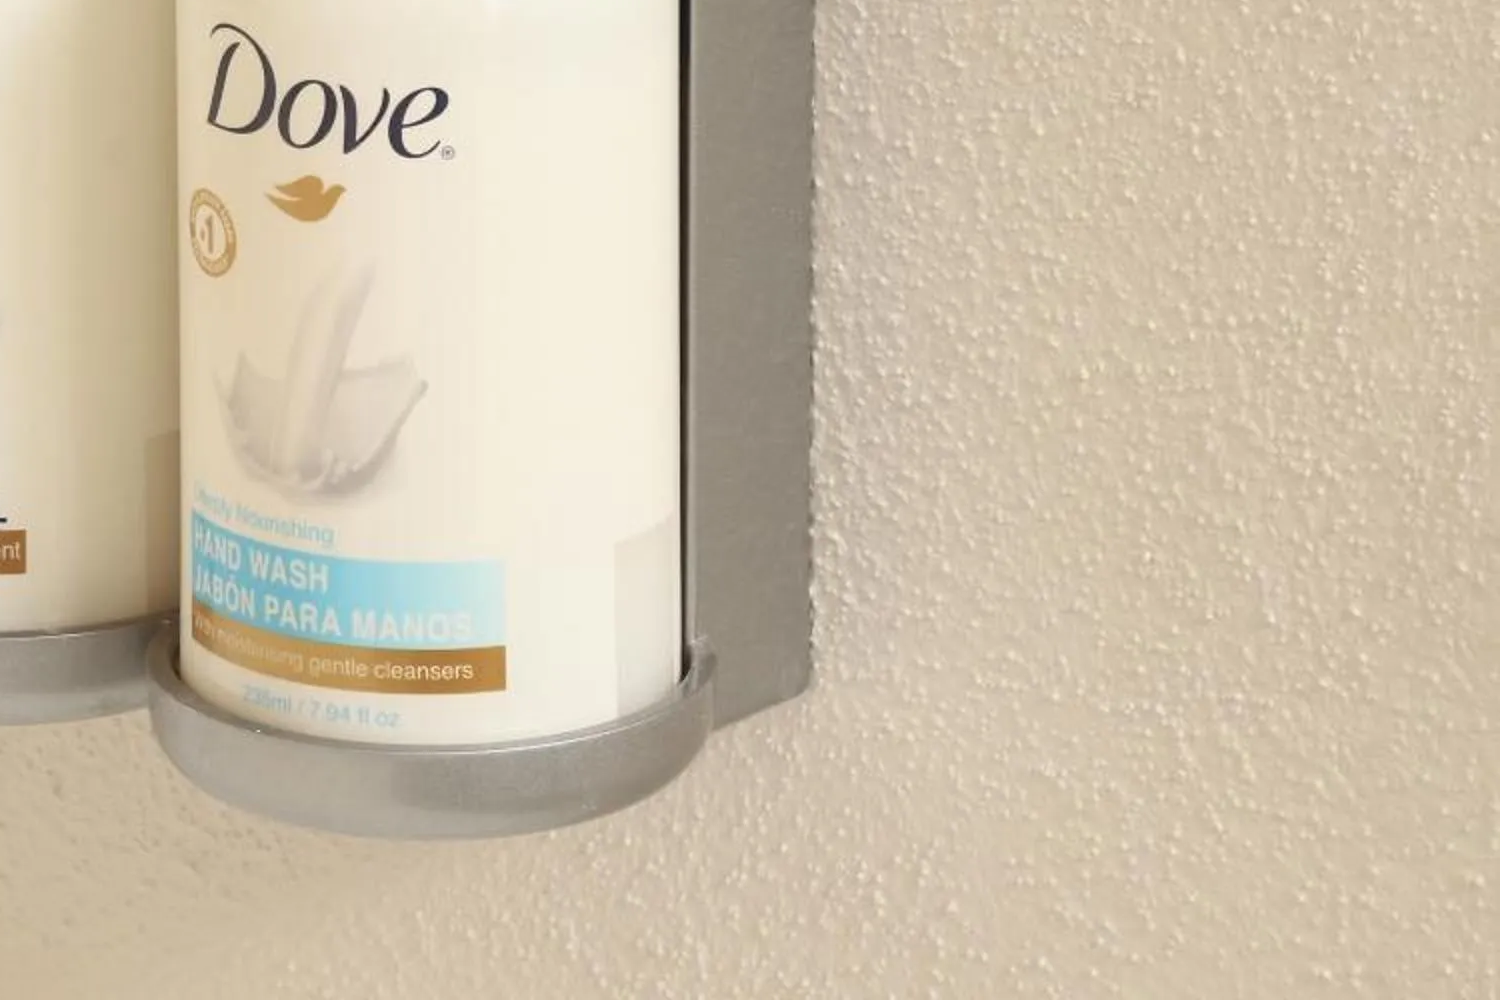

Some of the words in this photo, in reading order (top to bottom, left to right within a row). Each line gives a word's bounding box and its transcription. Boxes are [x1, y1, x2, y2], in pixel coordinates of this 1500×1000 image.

[206, 22, 450, 159] Dove
[194, 518, 241, 572] HAND
[249, 549, 330, 595] WASH
[193, 562, 256, 621] JABÓN
[263, 593, 342, 637] PARA
[352, 610, 475, 642] MANOS
[308, 654, 369, 681] gentle
[373, 656, 475, 681] cleansers
